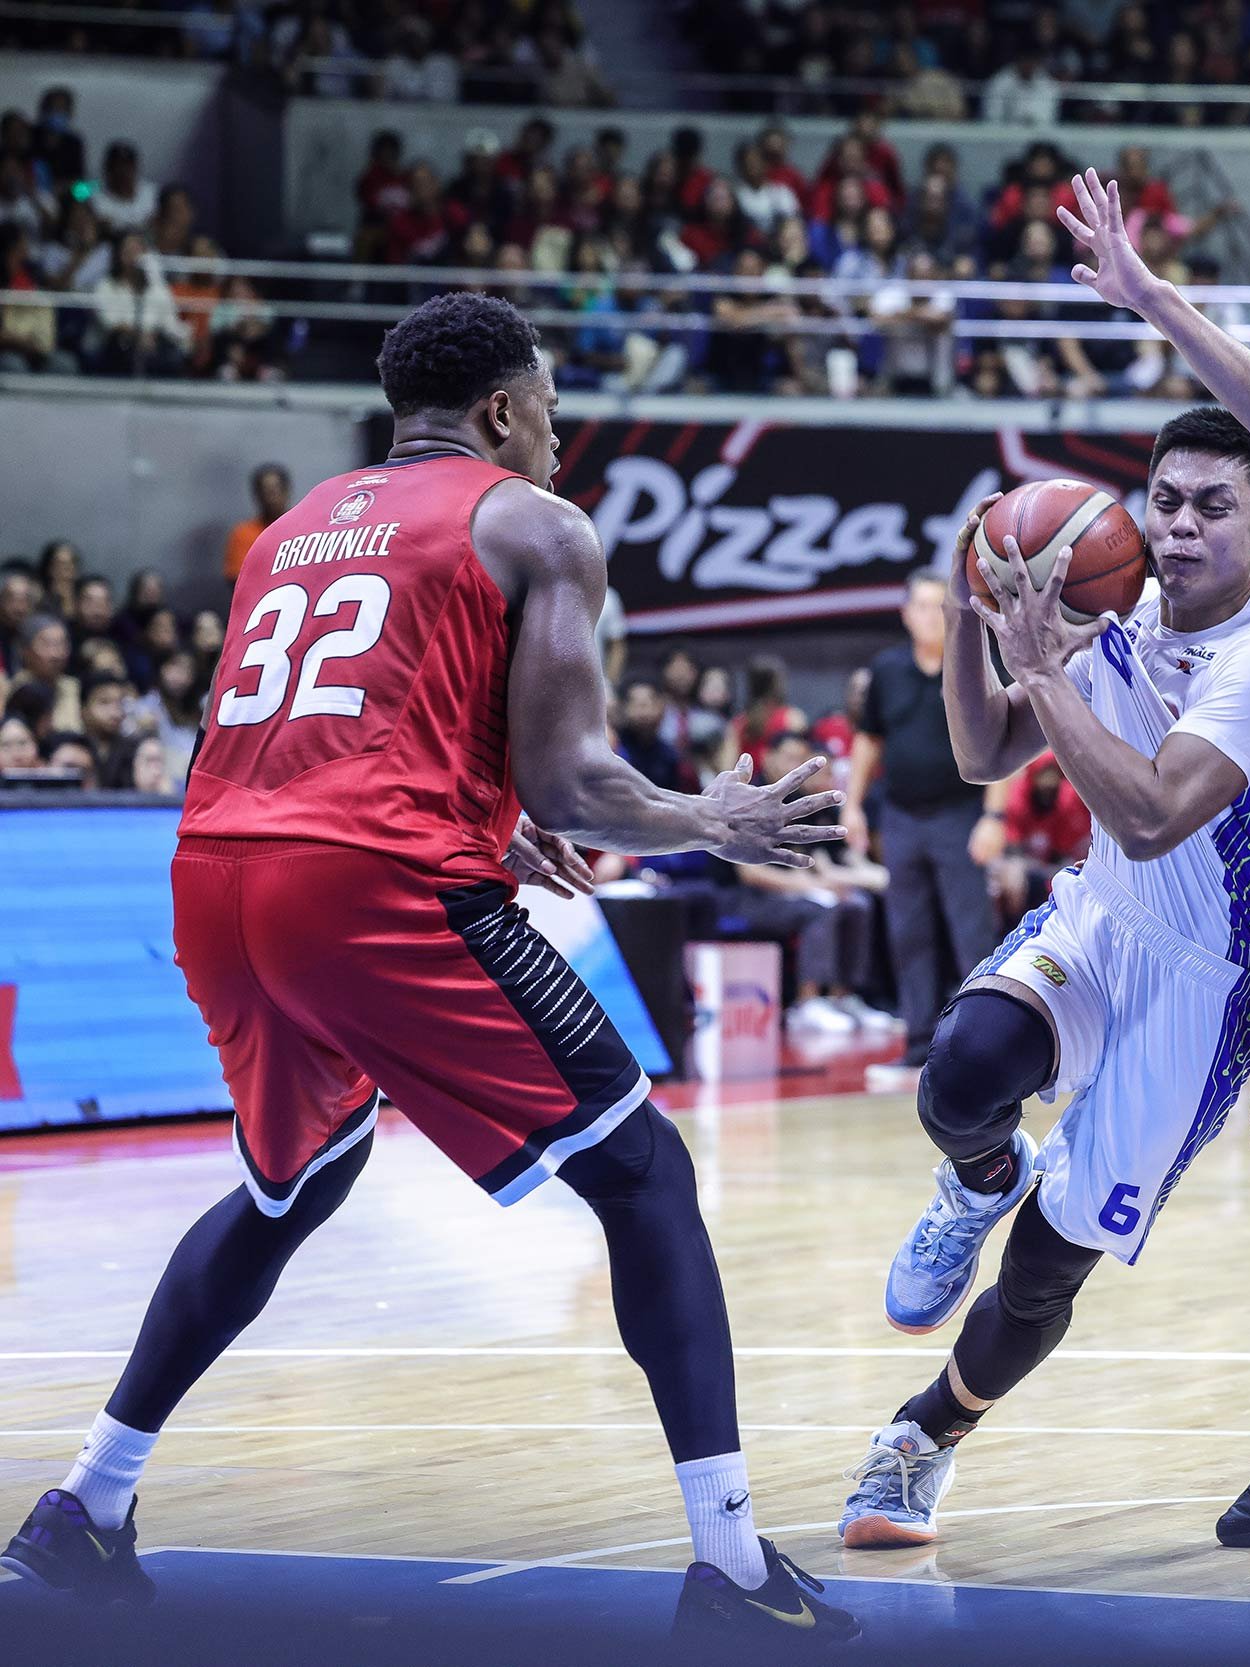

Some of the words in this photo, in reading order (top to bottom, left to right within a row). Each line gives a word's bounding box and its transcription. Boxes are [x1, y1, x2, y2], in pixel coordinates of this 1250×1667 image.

[594, 454, 917, 590] Pizza
[1104, 519, 1138, 551] molt
[271, 522, 400, 577] BROWNLEE
[216, 573, 391, 728] 32
[1181, 647, 1217, 661] FINALS
[1098, 1182, 1141, 1236] 6
